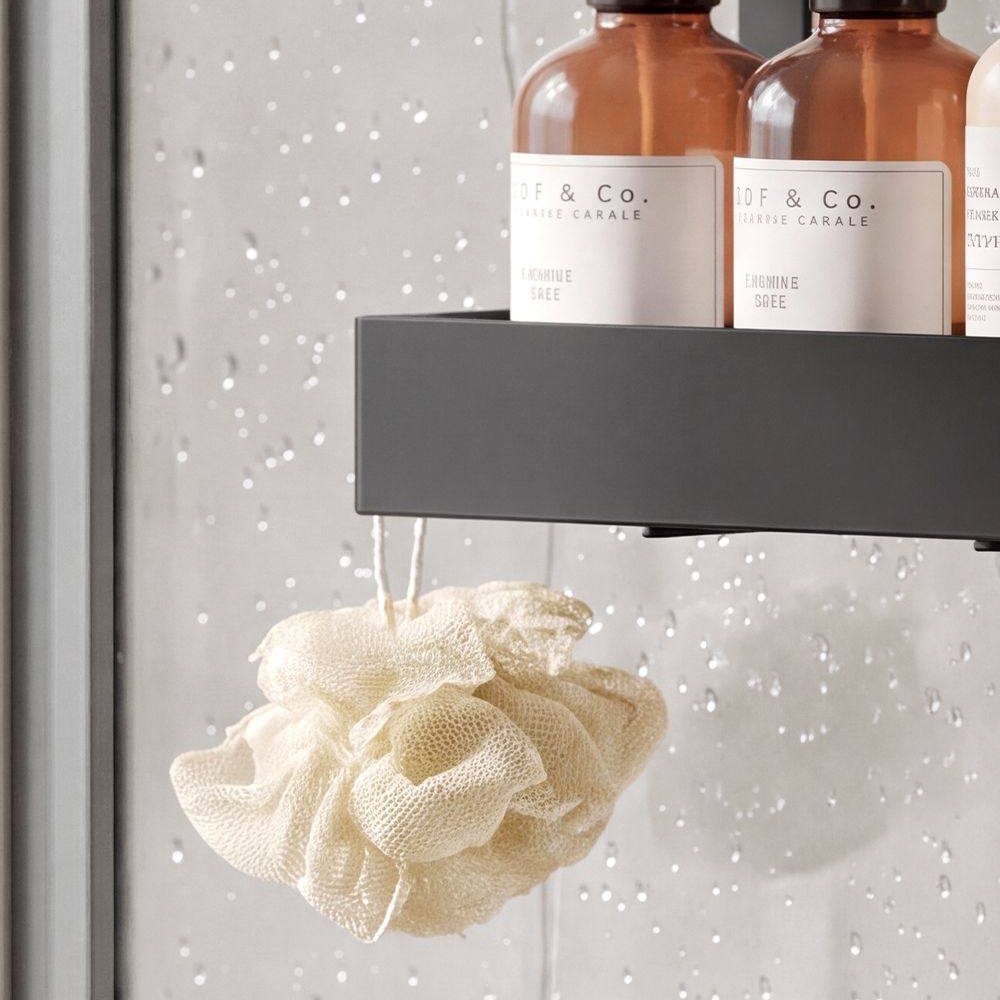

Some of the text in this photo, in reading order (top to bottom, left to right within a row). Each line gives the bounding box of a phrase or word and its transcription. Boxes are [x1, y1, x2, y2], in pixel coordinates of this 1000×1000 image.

[560, 183, 576, 202] &
[597, 184, 649, 203] Co.
[786, 188, 802, 208] &
[823, 189, 876, 210] Co.
[572, 209, 641, 221] CARALE
[798, 215, 869, 227] CARALE
